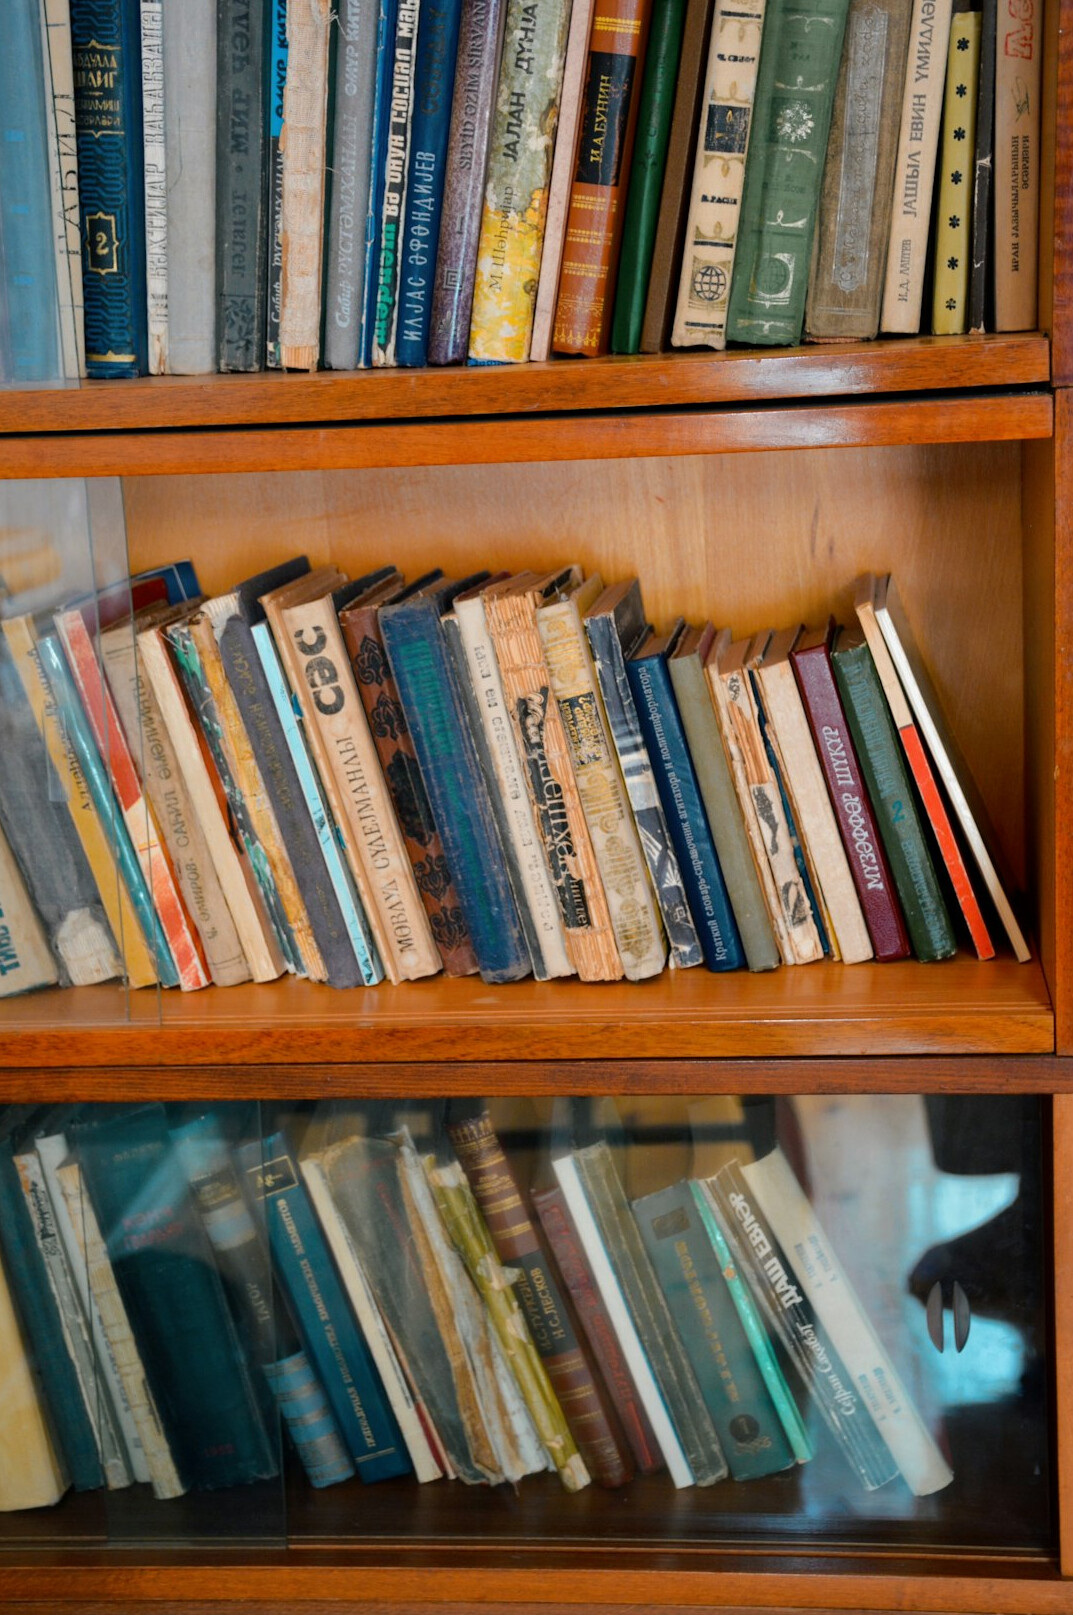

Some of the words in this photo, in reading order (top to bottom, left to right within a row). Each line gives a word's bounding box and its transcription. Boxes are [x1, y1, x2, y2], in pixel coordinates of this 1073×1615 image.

[915, 0, 936, 82] ҮМИДЛӘ
[462, 73, 481, 116] ƏZİM
[502, 92, 526, 162] ЈАЛАН
[514, 4, 539, 74] ДҮНЈА
[231, 88, 248, 154] МИР
[457, 120, 475, 170] SEYİD
[909, 94, 927, 141] ЕВИН
[386, 136, 405, 183] онун
[903, 151, 921, 217] ЈАШЫЛ
[1010, 136, 1020, 238] ЈАЗЫЧЫЛАРЫНЫН
[1021, 136, 1030, 189] ӘСӘРЛӘРИ
[385, 191, 401, 216] вә
[411, 152, 437, 265] ӘФӘНДИЈЕВ
[490, 186, 515, 267] Шәһријар
[96, 232, 108, 255] 2
[898, 239, 912, 276] ЛАПТЕВ
[1010, 243, 1020, 272] ИРАН
[335, 281, 354, 328] Сабир
[489, 271, 503, 290] М.
[403, 277, 427, 341] ИЛЈАС
[292, 624, 348, 718] СӘС
[635, 665, 673, 761] политинформатора
[663, 761, 674, 770] и
[820, 722, 855, 788] ШҮКҮР
[162, 789, 190, 848] САҺИЛ
[335, 735, 392, 871] СҮЛЕЈМАНЛЫ
[665, 770, 689, 820] агитатора
[891, 800, 905, 823] 2
[678, 820, 716, 918] словарь-справочник
[839, 789, 885, 893] МҮЗӘФФӘР
[705, 918, 727, 961] Краткий
[727, 1188, 777, 1258] ЕВЛӘР
[765, 1255, 803, 1309] ДАШ
